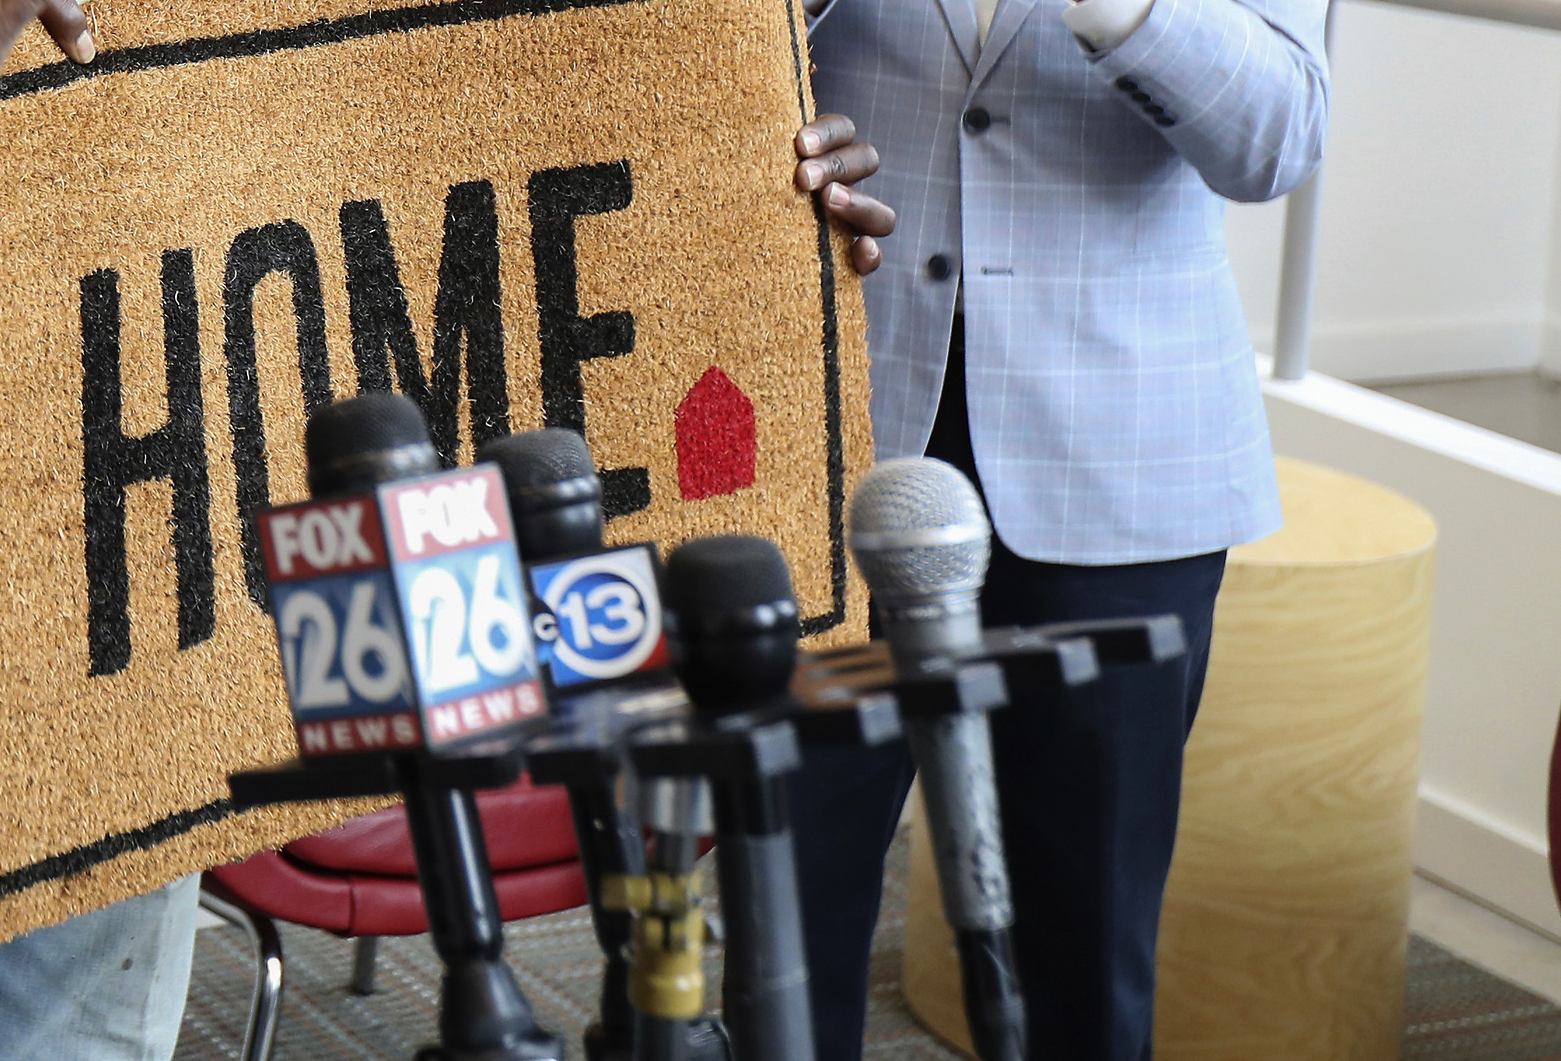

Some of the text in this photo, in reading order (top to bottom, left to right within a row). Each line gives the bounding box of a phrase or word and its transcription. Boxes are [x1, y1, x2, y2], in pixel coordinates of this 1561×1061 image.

[80, 160, 650, 676] HOME
[269, 504, 375, 576] FOX
[397, 476, 499, 555] FOX
[280, 581, 407, 709] 26
[410, 554, 526, 693] 26
[558, 581, 645, 651] 13
[301, 713, 417, 752] NEWS
[433, 683, 541, 738] NEWS
